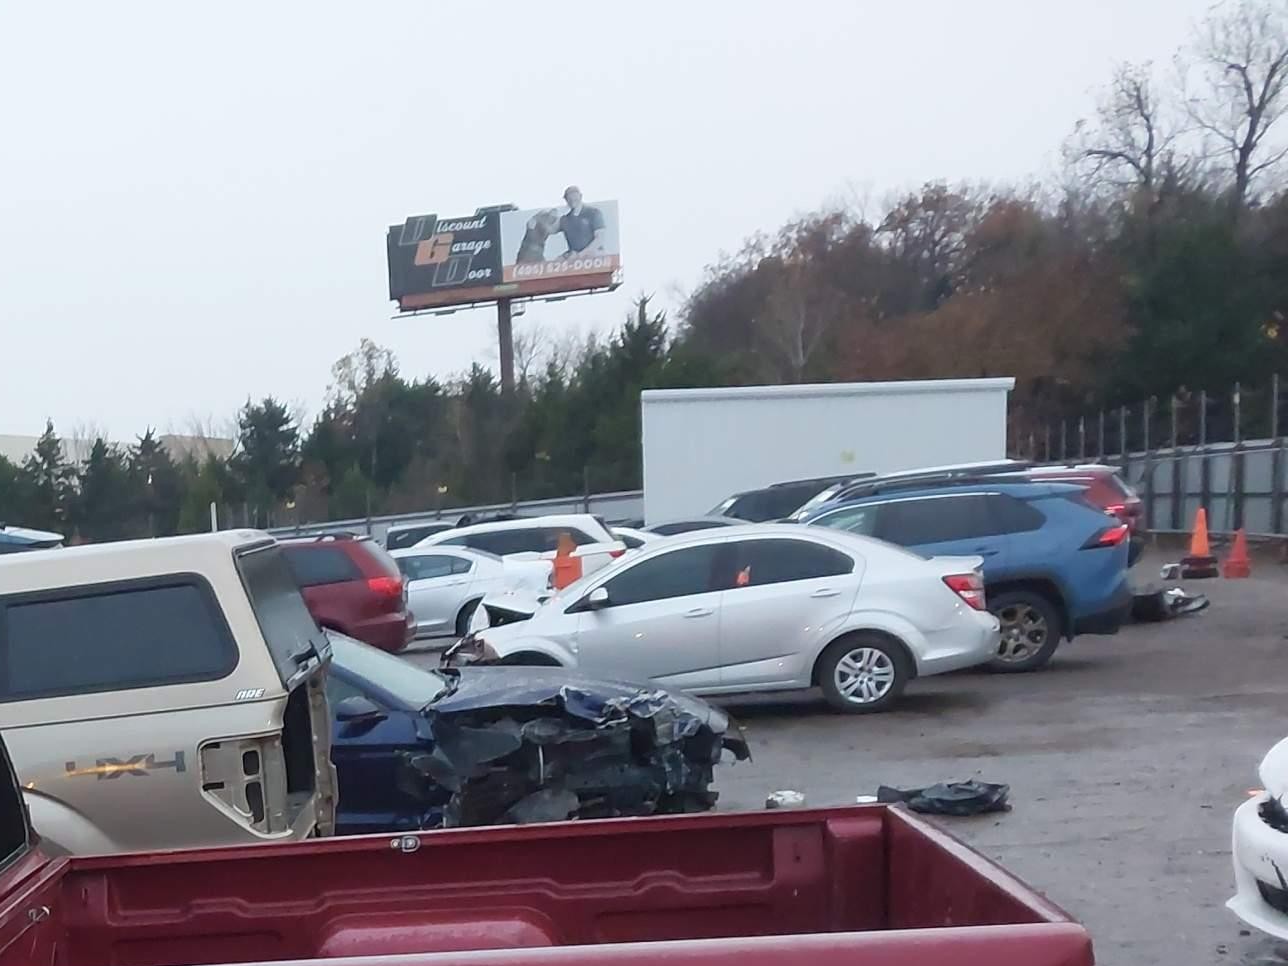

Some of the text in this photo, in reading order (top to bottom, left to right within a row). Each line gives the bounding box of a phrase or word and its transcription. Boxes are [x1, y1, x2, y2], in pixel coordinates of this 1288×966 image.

[398, 214, 487, 246] Discount
[414, 233, 491, 266] Garage
[432, 254, 492, 287] Door
